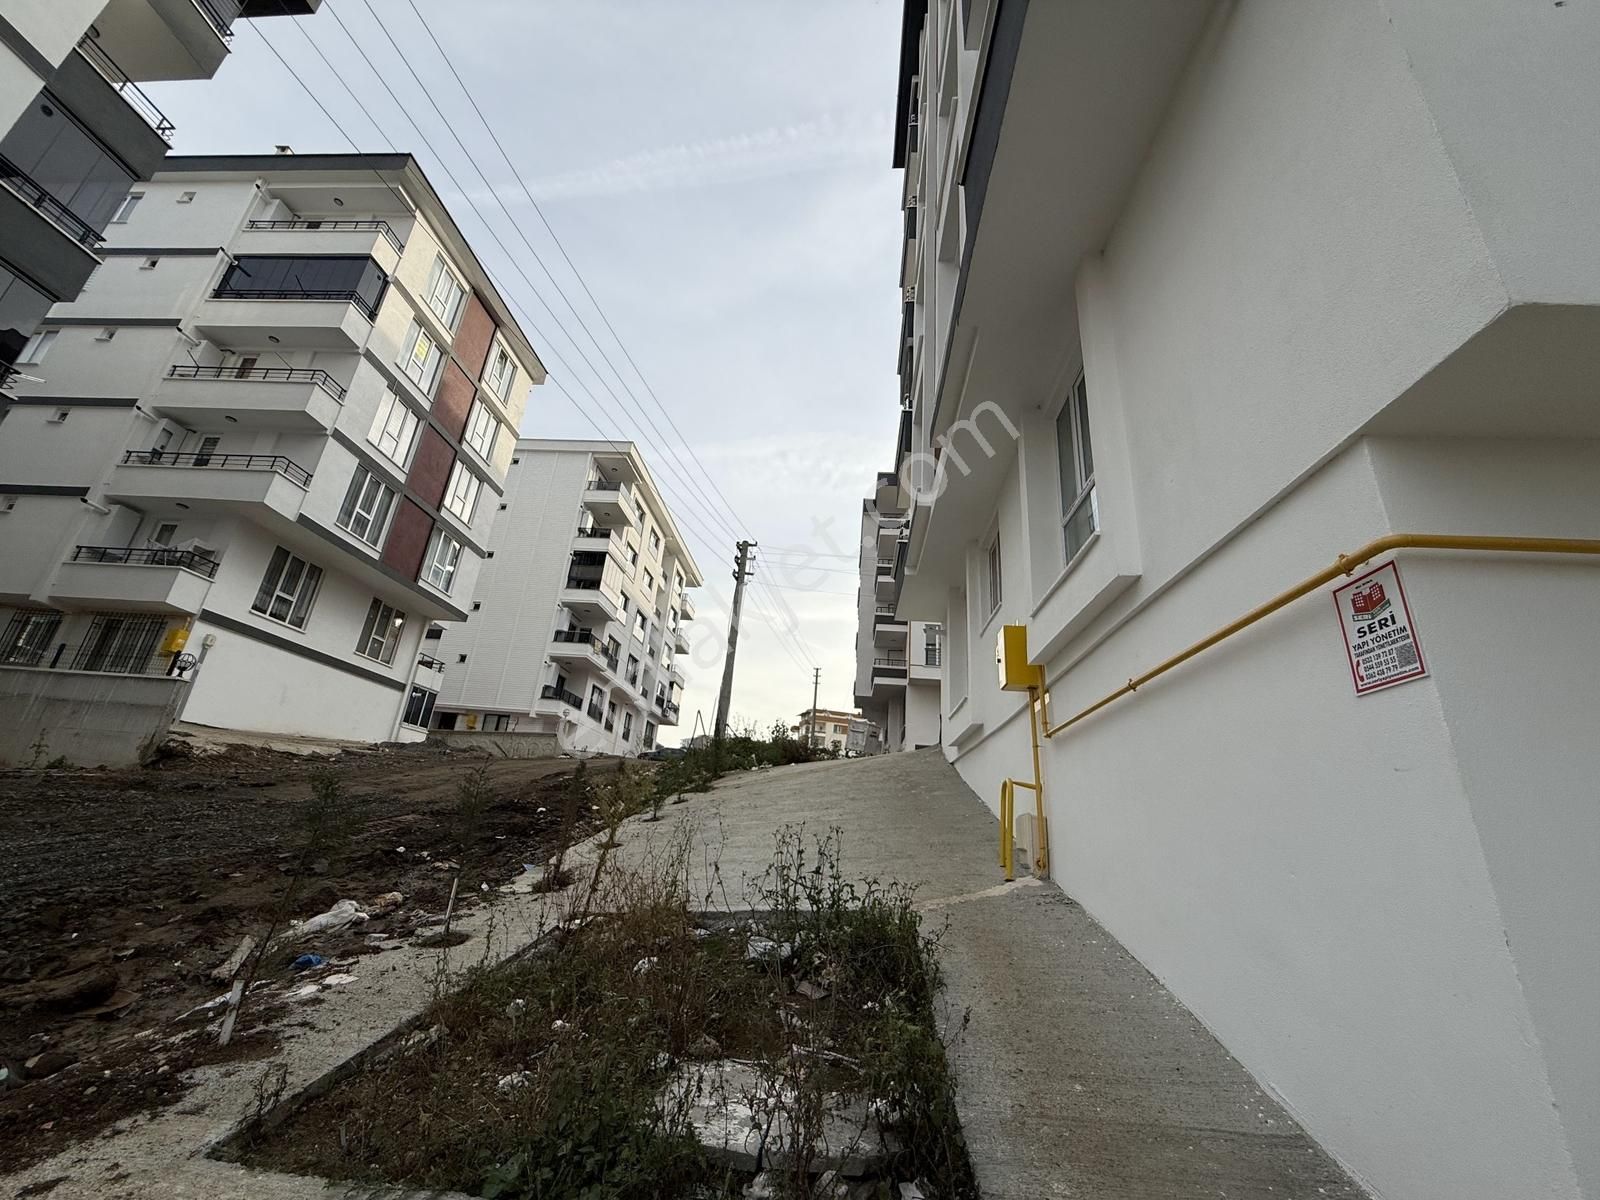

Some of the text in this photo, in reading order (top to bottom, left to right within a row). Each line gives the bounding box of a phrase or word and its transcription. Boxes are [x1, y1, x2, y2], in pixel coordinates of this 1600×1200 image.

[1352, 624, 1407, 652] YAPI YÖNETİM
[1357, 611, 1396, 638] SERİ
